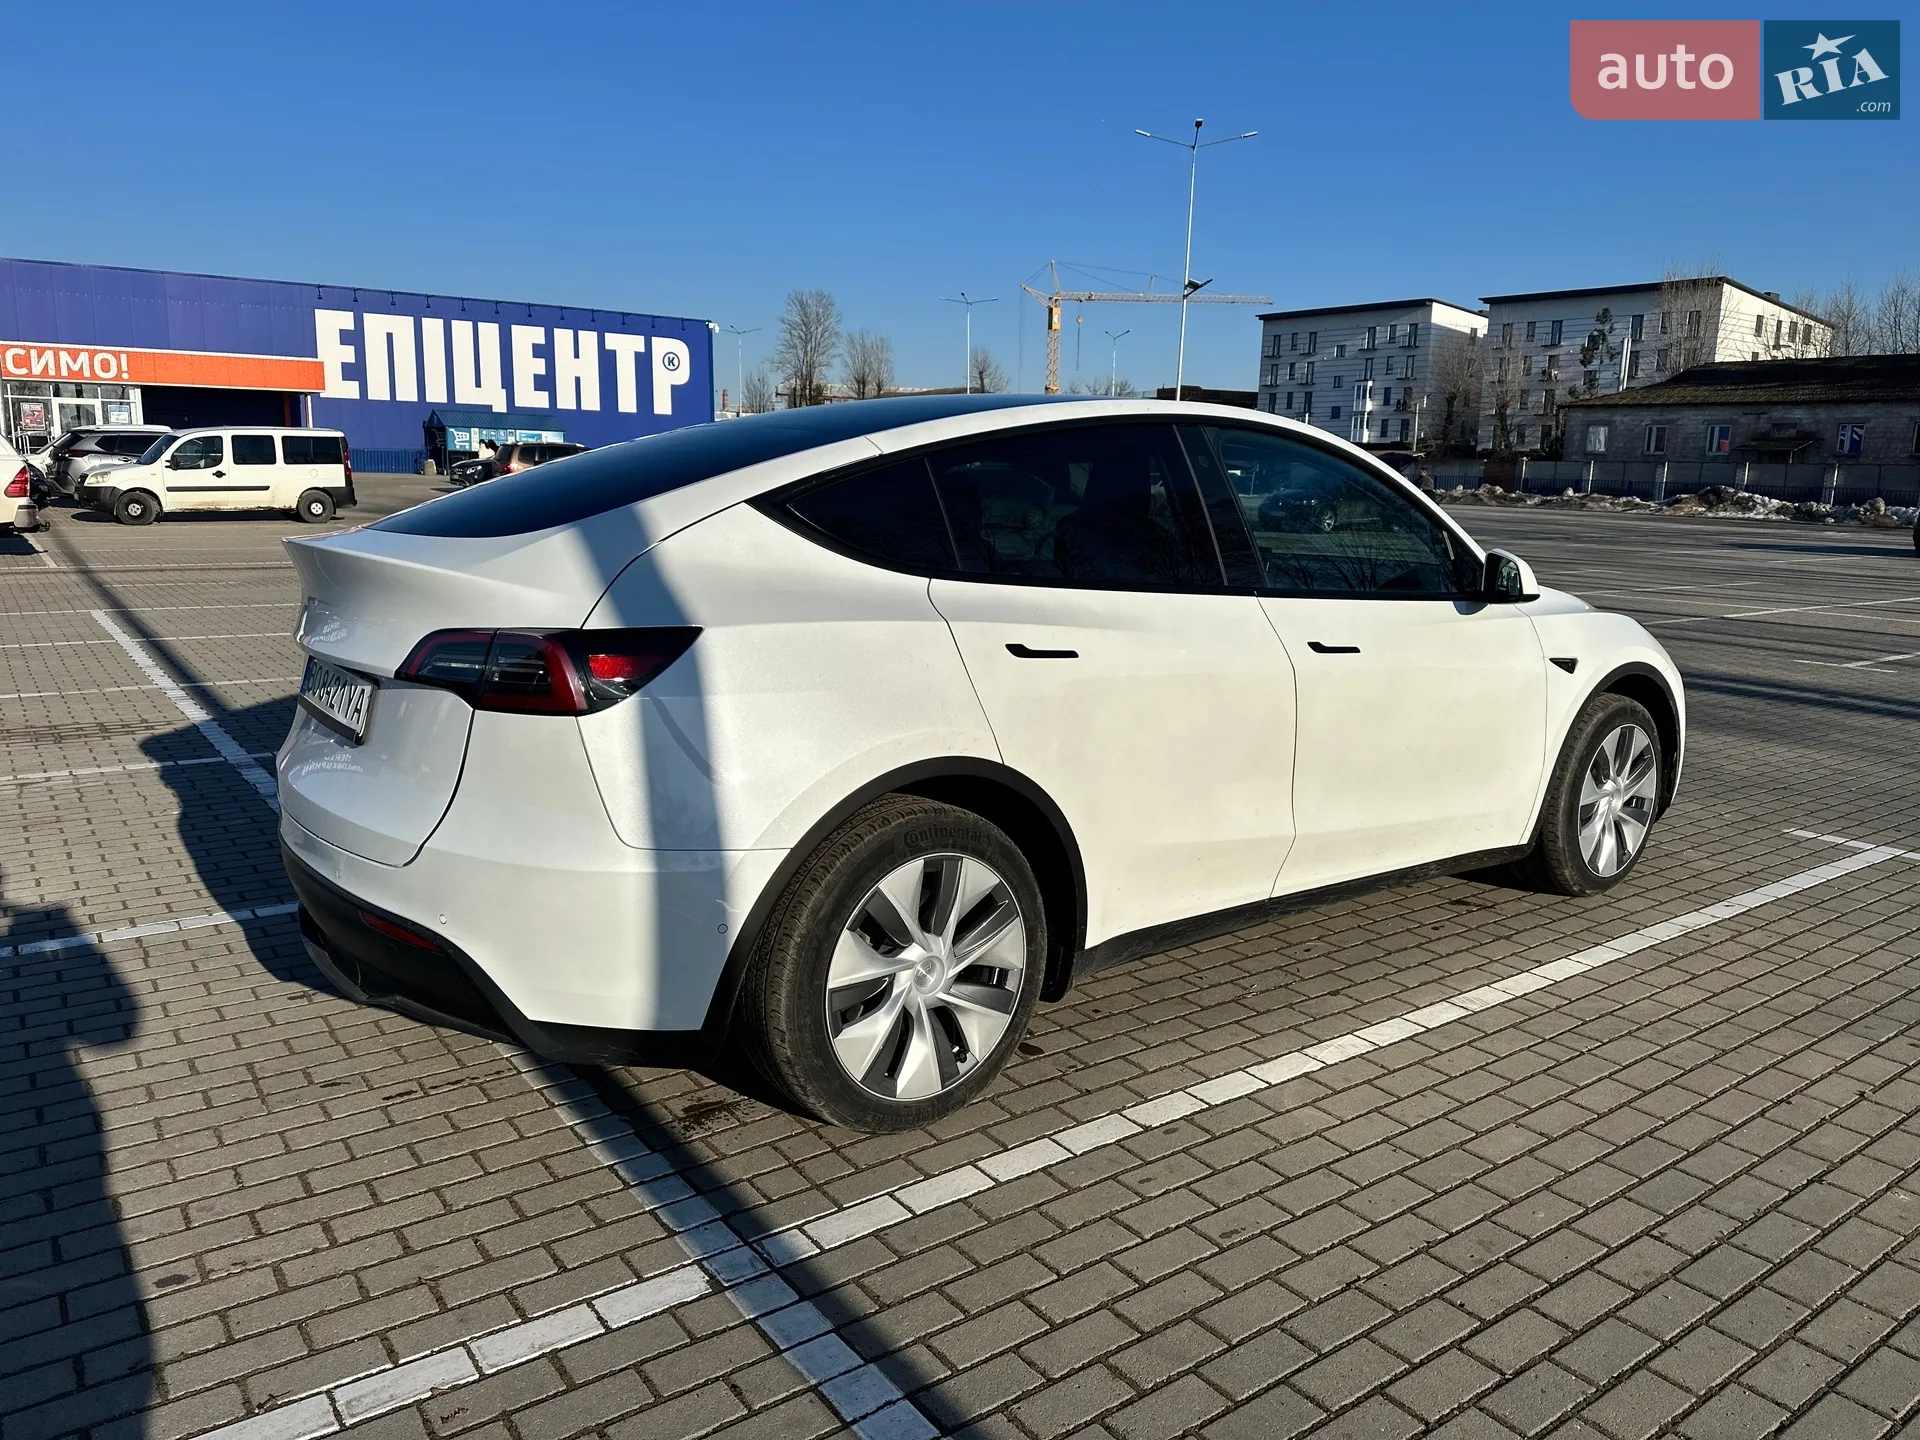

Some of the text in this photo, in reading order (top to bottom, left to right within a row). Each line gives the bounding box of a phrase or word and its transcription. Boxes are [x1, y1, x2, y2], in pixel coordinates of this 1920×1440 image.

[4, 347, 130, 380] СИМО!
[314, 308, 691, 415] ЕПІЦЕНТР
[903, 823, 983, 848] Continental
